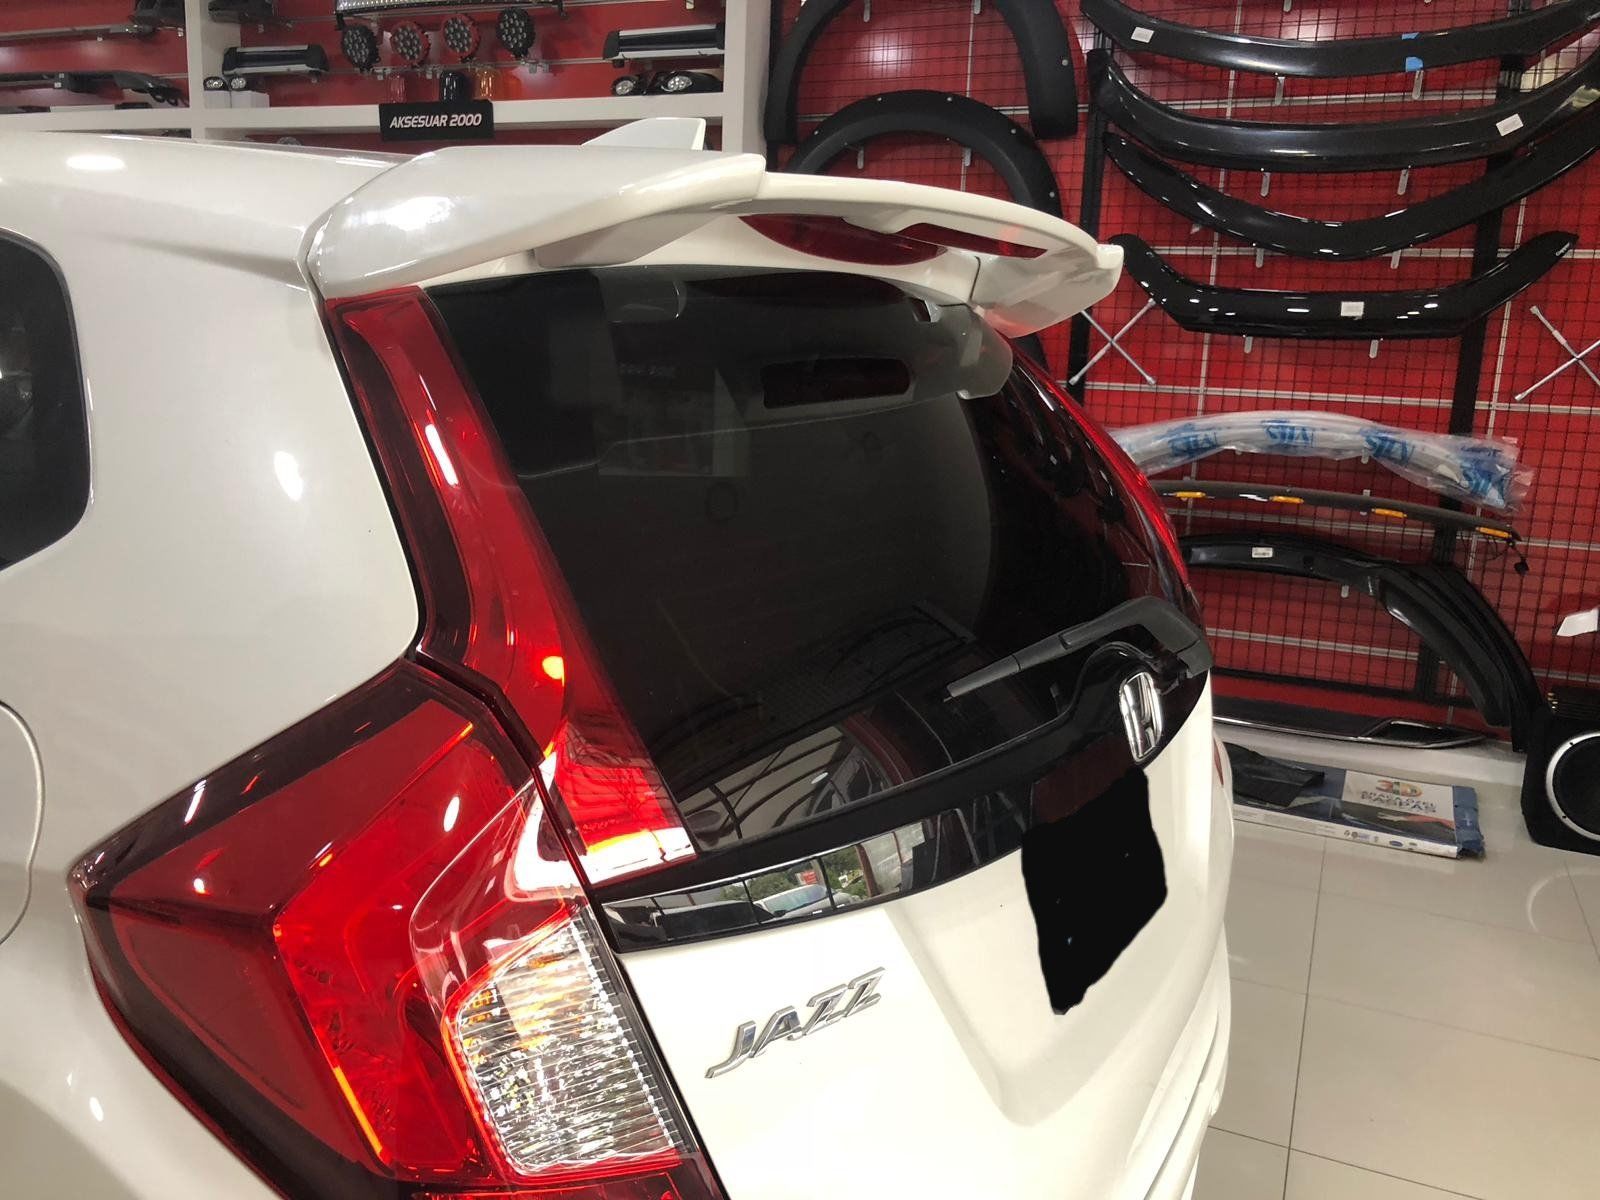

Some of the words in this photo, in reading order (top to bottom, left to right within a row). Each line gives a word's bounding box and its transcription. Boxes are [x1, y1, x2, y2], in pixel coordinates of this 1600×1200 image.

[389, 115, 447, 129] AKSESUAR
[449, 113, 482, 127] 2000
[704, 966, 886, 1079] JAZZ
